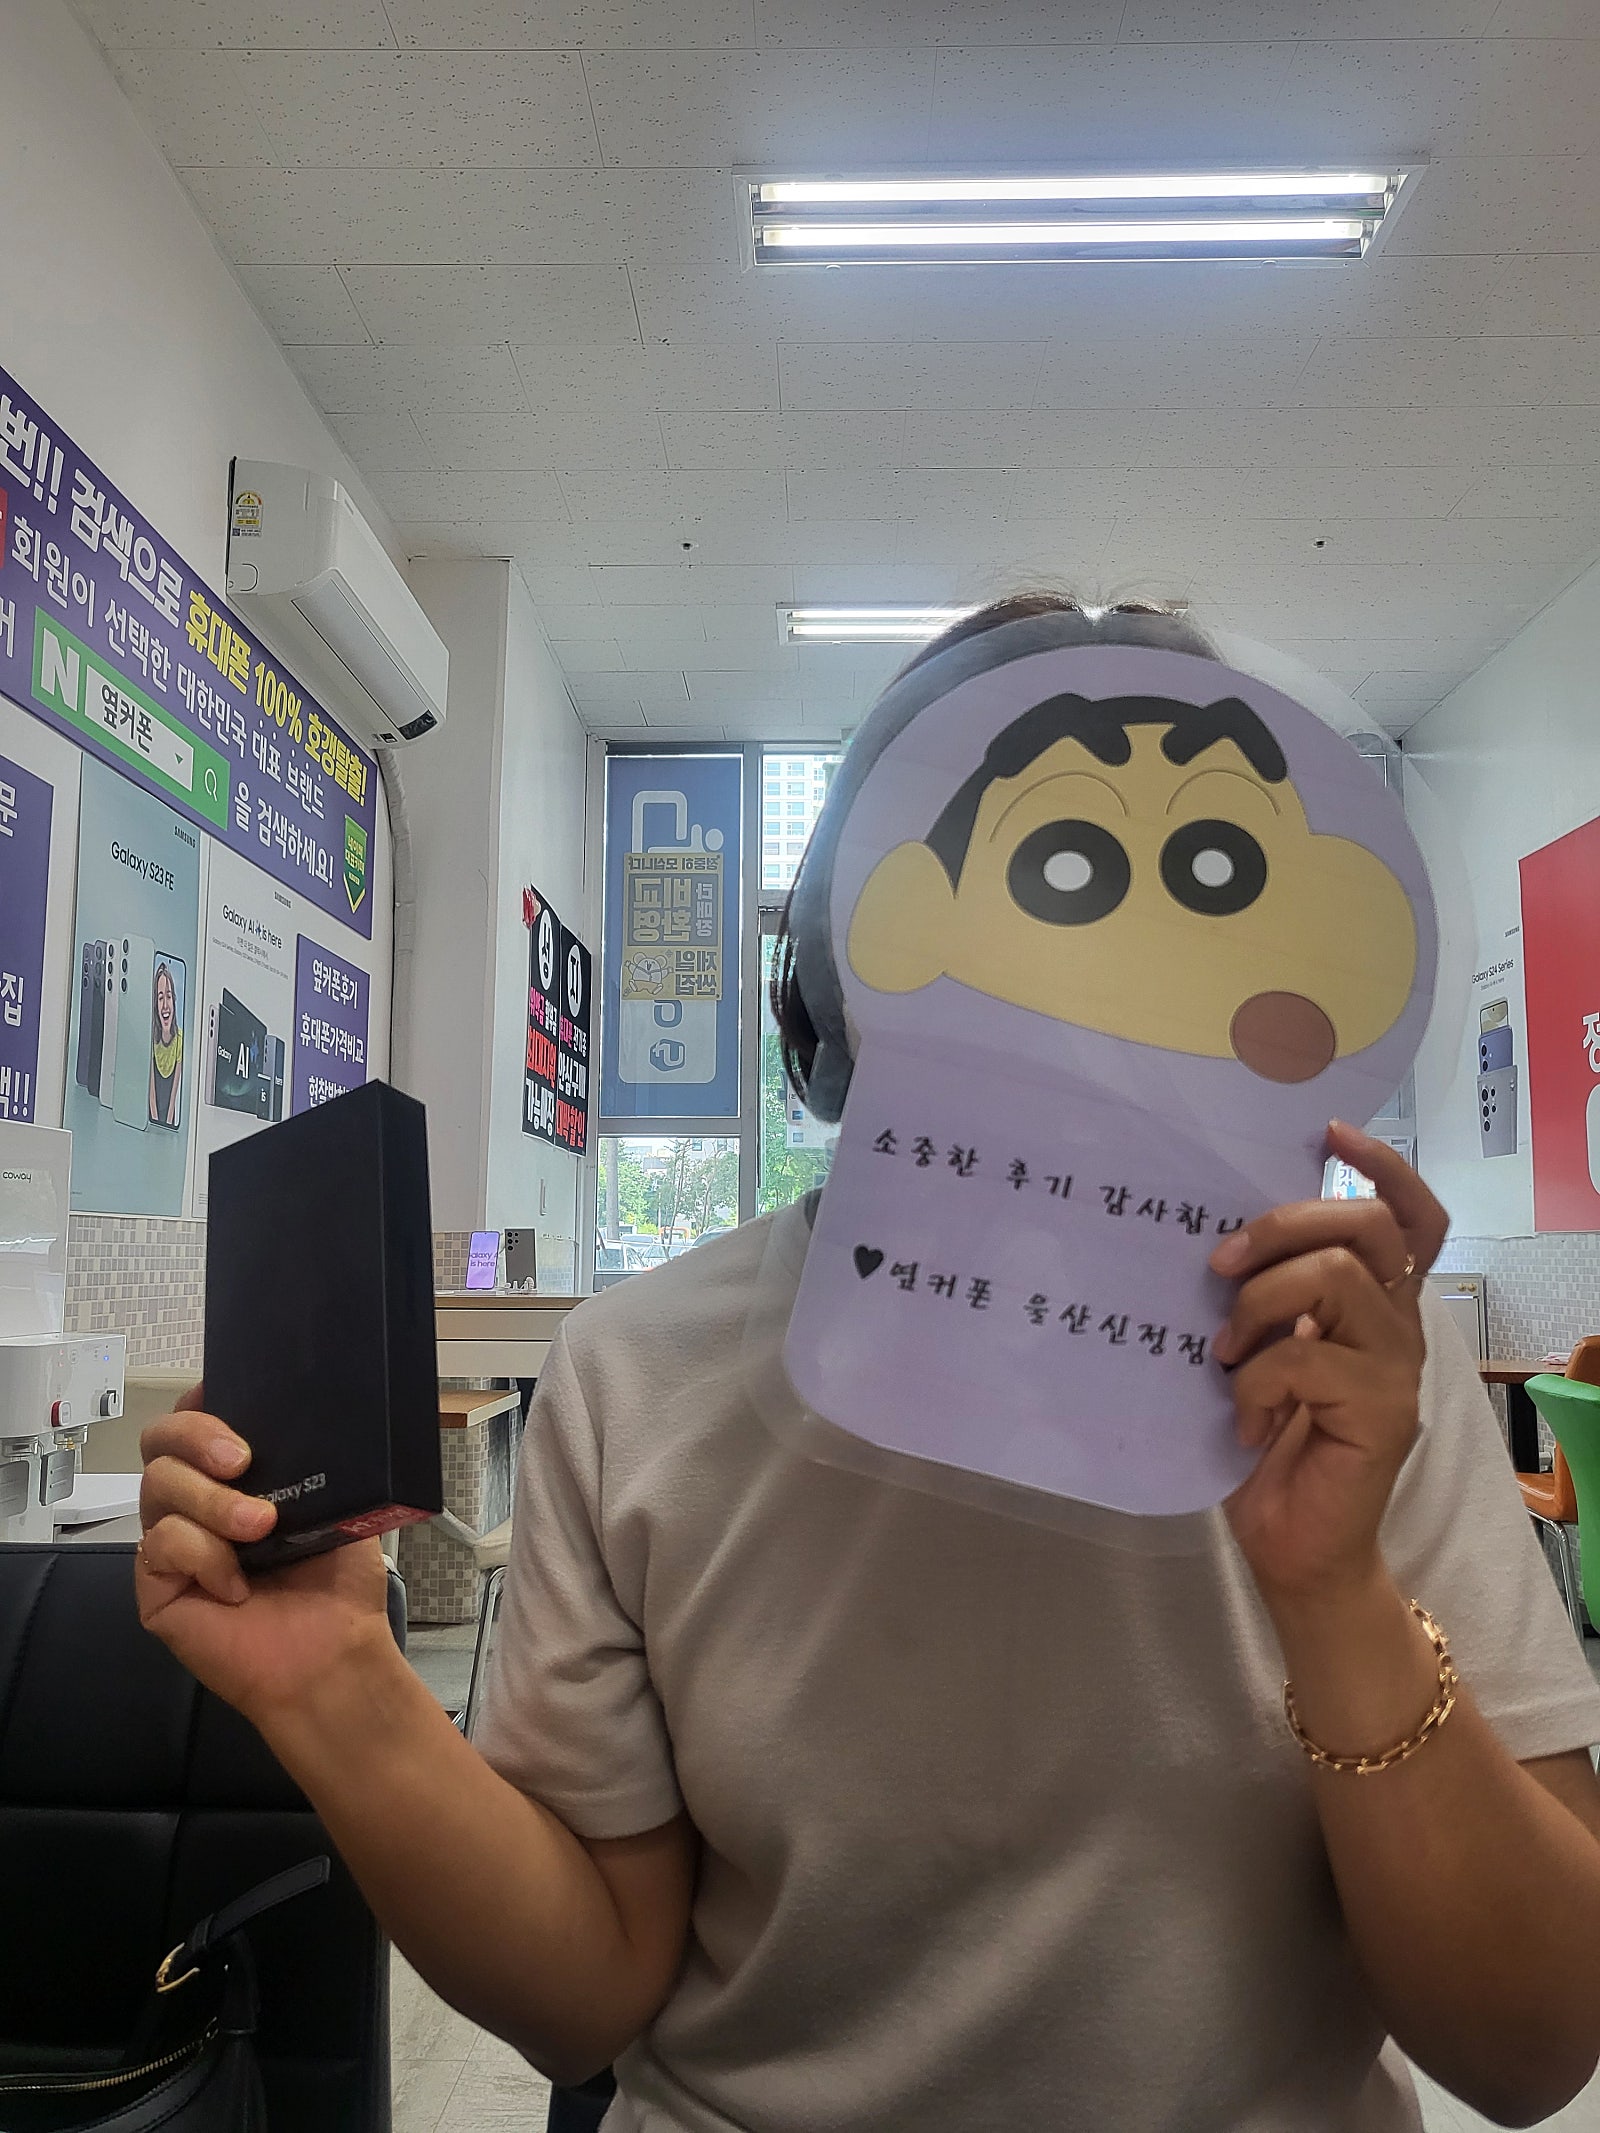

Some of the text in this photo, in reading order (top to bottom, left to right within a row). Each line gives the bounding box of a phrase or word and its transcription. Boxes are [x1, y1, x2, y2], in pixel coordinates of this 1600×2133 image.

[70, 468, 184, 628] 검색으로
[185, 590, 252, 695] 휴대폰
[254, 661, 302, 744] 100%
[305, 712, 368, 807] 호갱탈출!
[11, 515, 96, 628] 회원이
[104, 598, 171, 693] 선택한
[177, 662, 247, 759] 대한민국
[252, 726, 282, 784] 대표
[286, 758, 325, 820] 브랜드
[101, 684, 153, 754] 옆커폰
[234, 780, 252, 832] 을
[257, 798, 334, 889] 검색하세요!
[174, 825, 196, 848] SAMSUNG
[112, 841, 175, 891] Galaxy S23 FE
[222, 904, 247, 934] Galaxy
[268, 929, 282, 949] here
[313, 959, 358, 1009] 옆커폰후기
[1472, 970, 1489, 984] Galaxy
[1489, 964, 1498, 977] S24
[1498, 958, 1514, 973] Series
[235, 1043, 249, 1079] AI
[300, 1012, 364, 1064] 휴대폰가격비교
[558, 1051, 586, 1100] 안심구매
[3, 1171, 31, 1183] coway
[872, 1128, 979, 1177] 소중한
[1006, 1157, 1073, 1199] 후기
[889, 1261, 992, 1310] 옆커폰
[258, 1472, 327, 1504] alaxy S23
